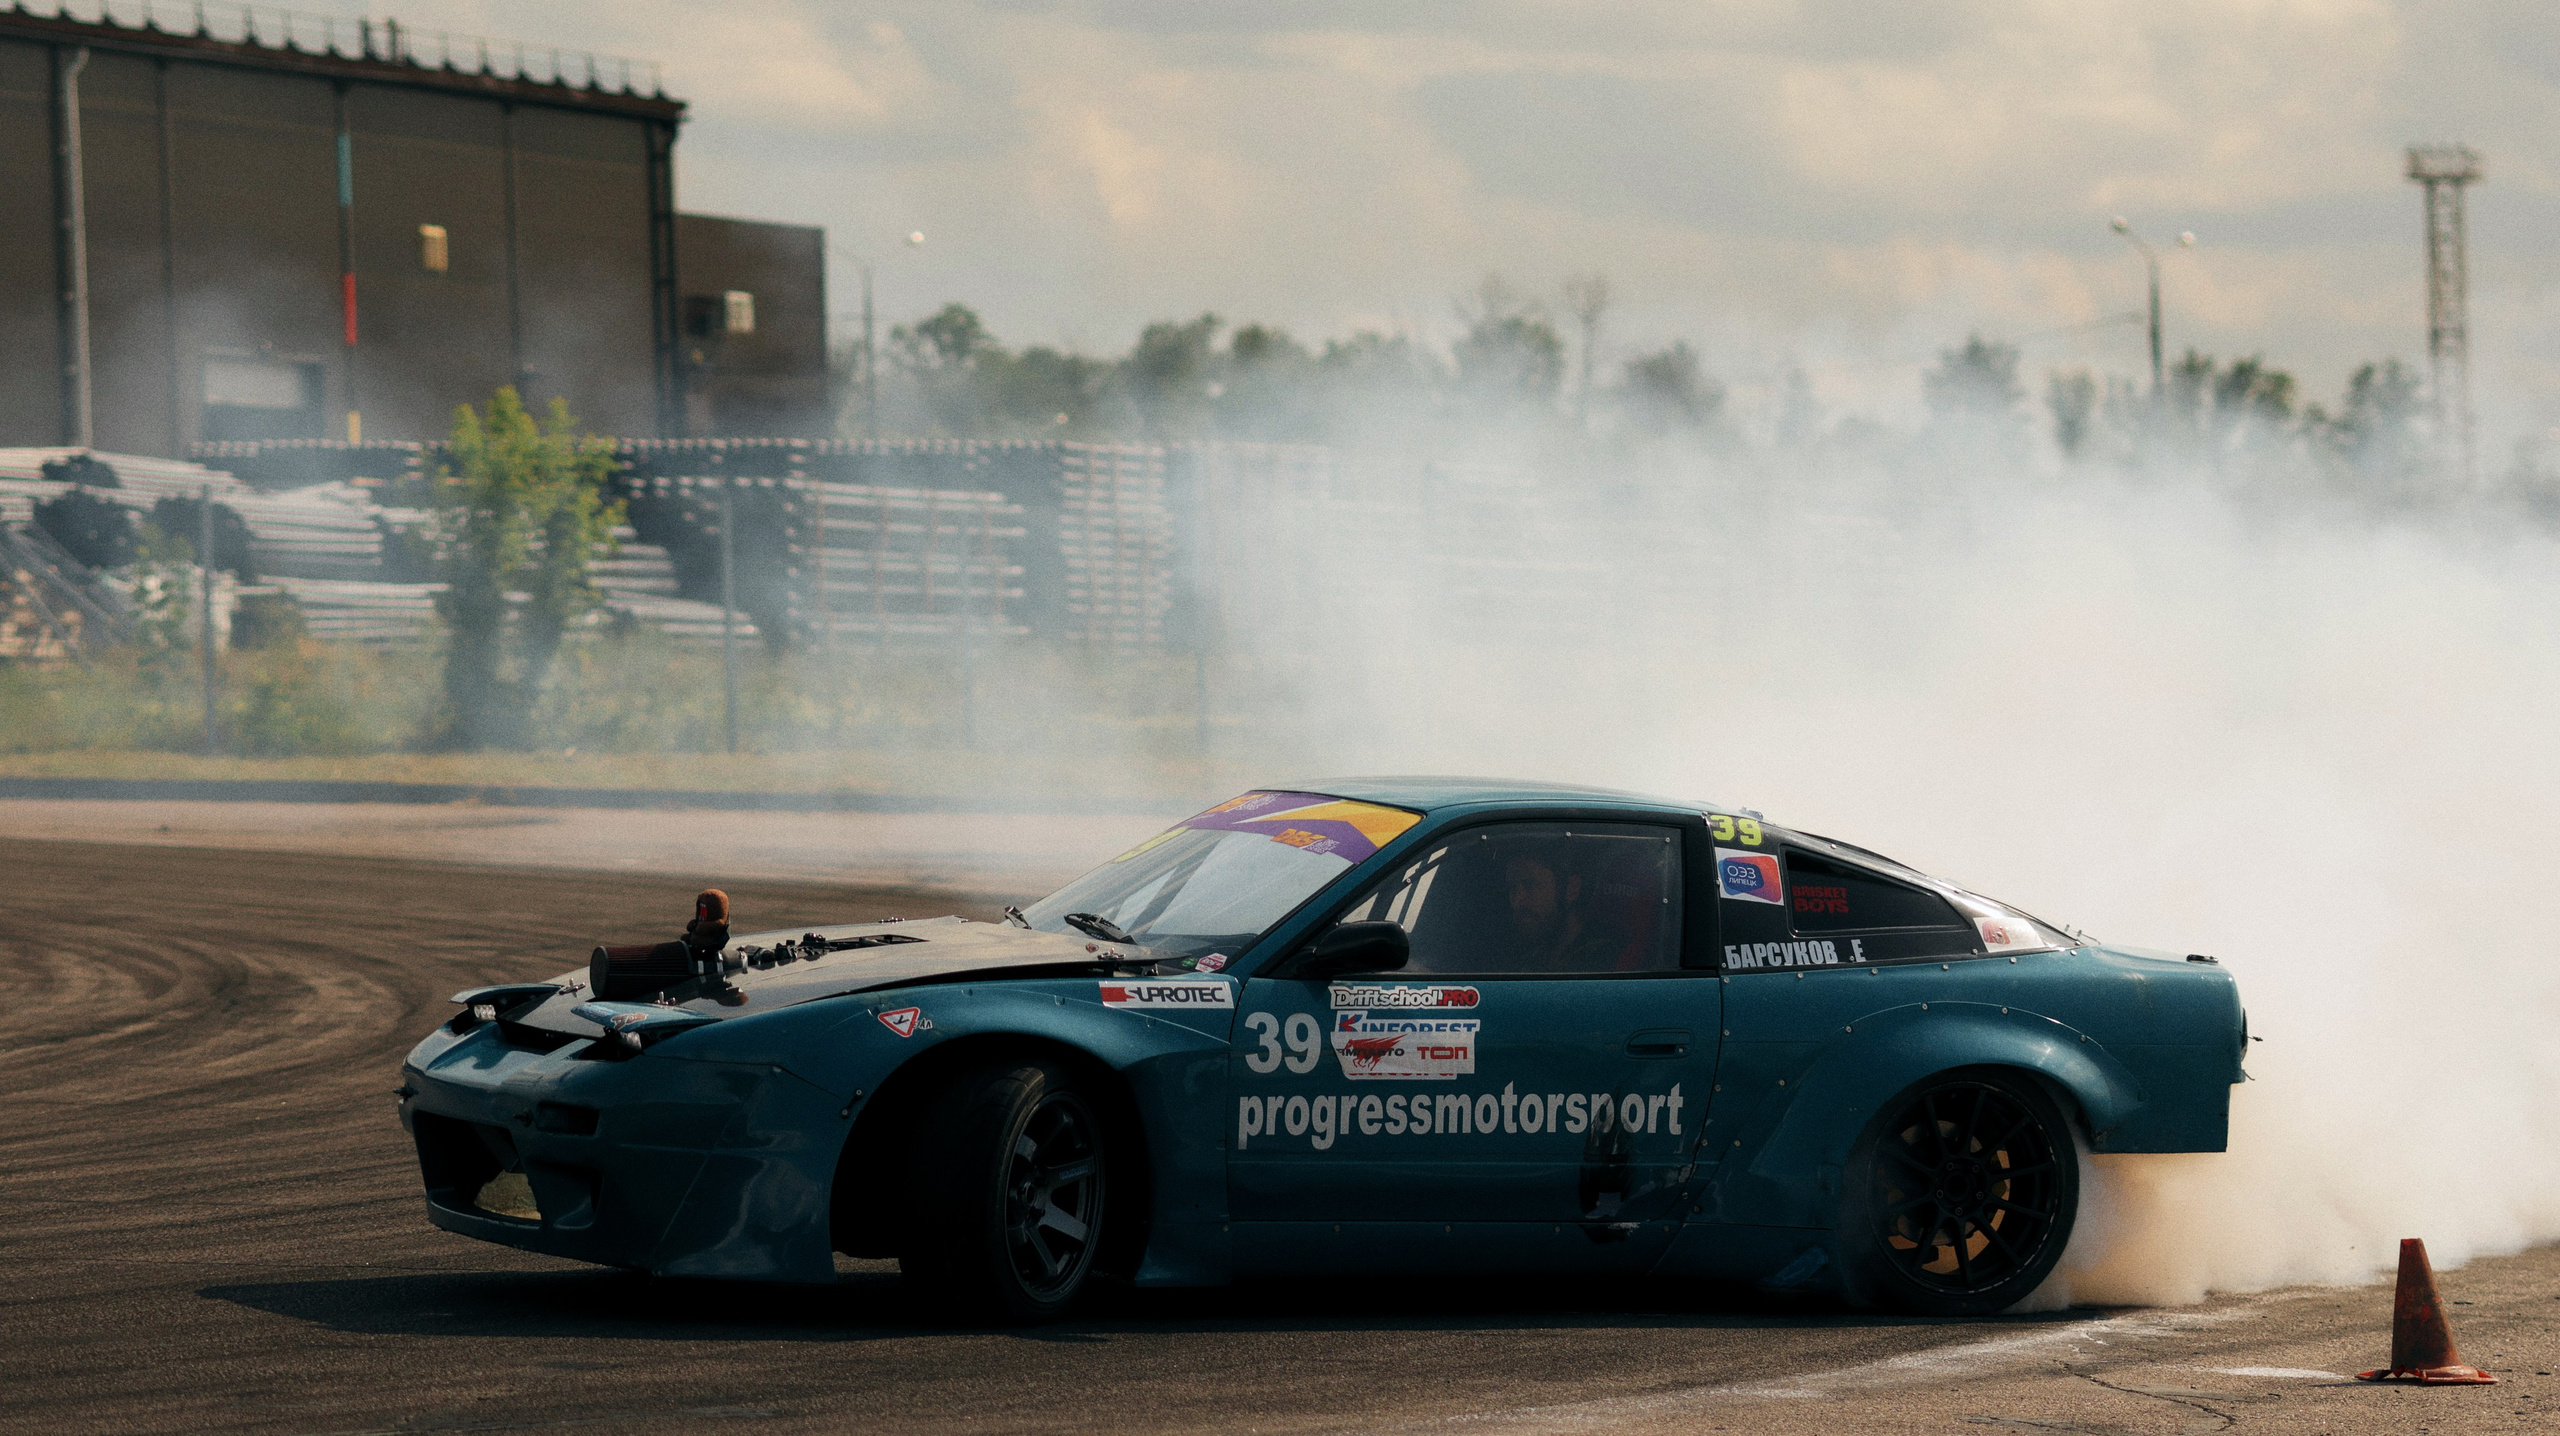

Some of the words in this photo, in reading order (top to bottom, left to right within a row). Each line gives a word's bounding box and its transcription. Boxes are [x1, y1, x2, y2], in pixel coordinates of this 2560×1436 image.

[1710, 814, 1762, 846] 39
[1727, 865, 1757, 879] ОЭЗ
[1728, 877, 1758, 887] ЛИПЕЦК
[1791, 885, 1848, 899] BRISKET
[1793, 897, 1850, 915] BOYS
[1724, 940, 1839, 970] БАРСУКОВ
[1124, 986, 1226, 1003] SUPROTEC
[1244, 1011, 1322, 1074] 39
[1237, 1081, 1684, 1151] progressmotorsport
